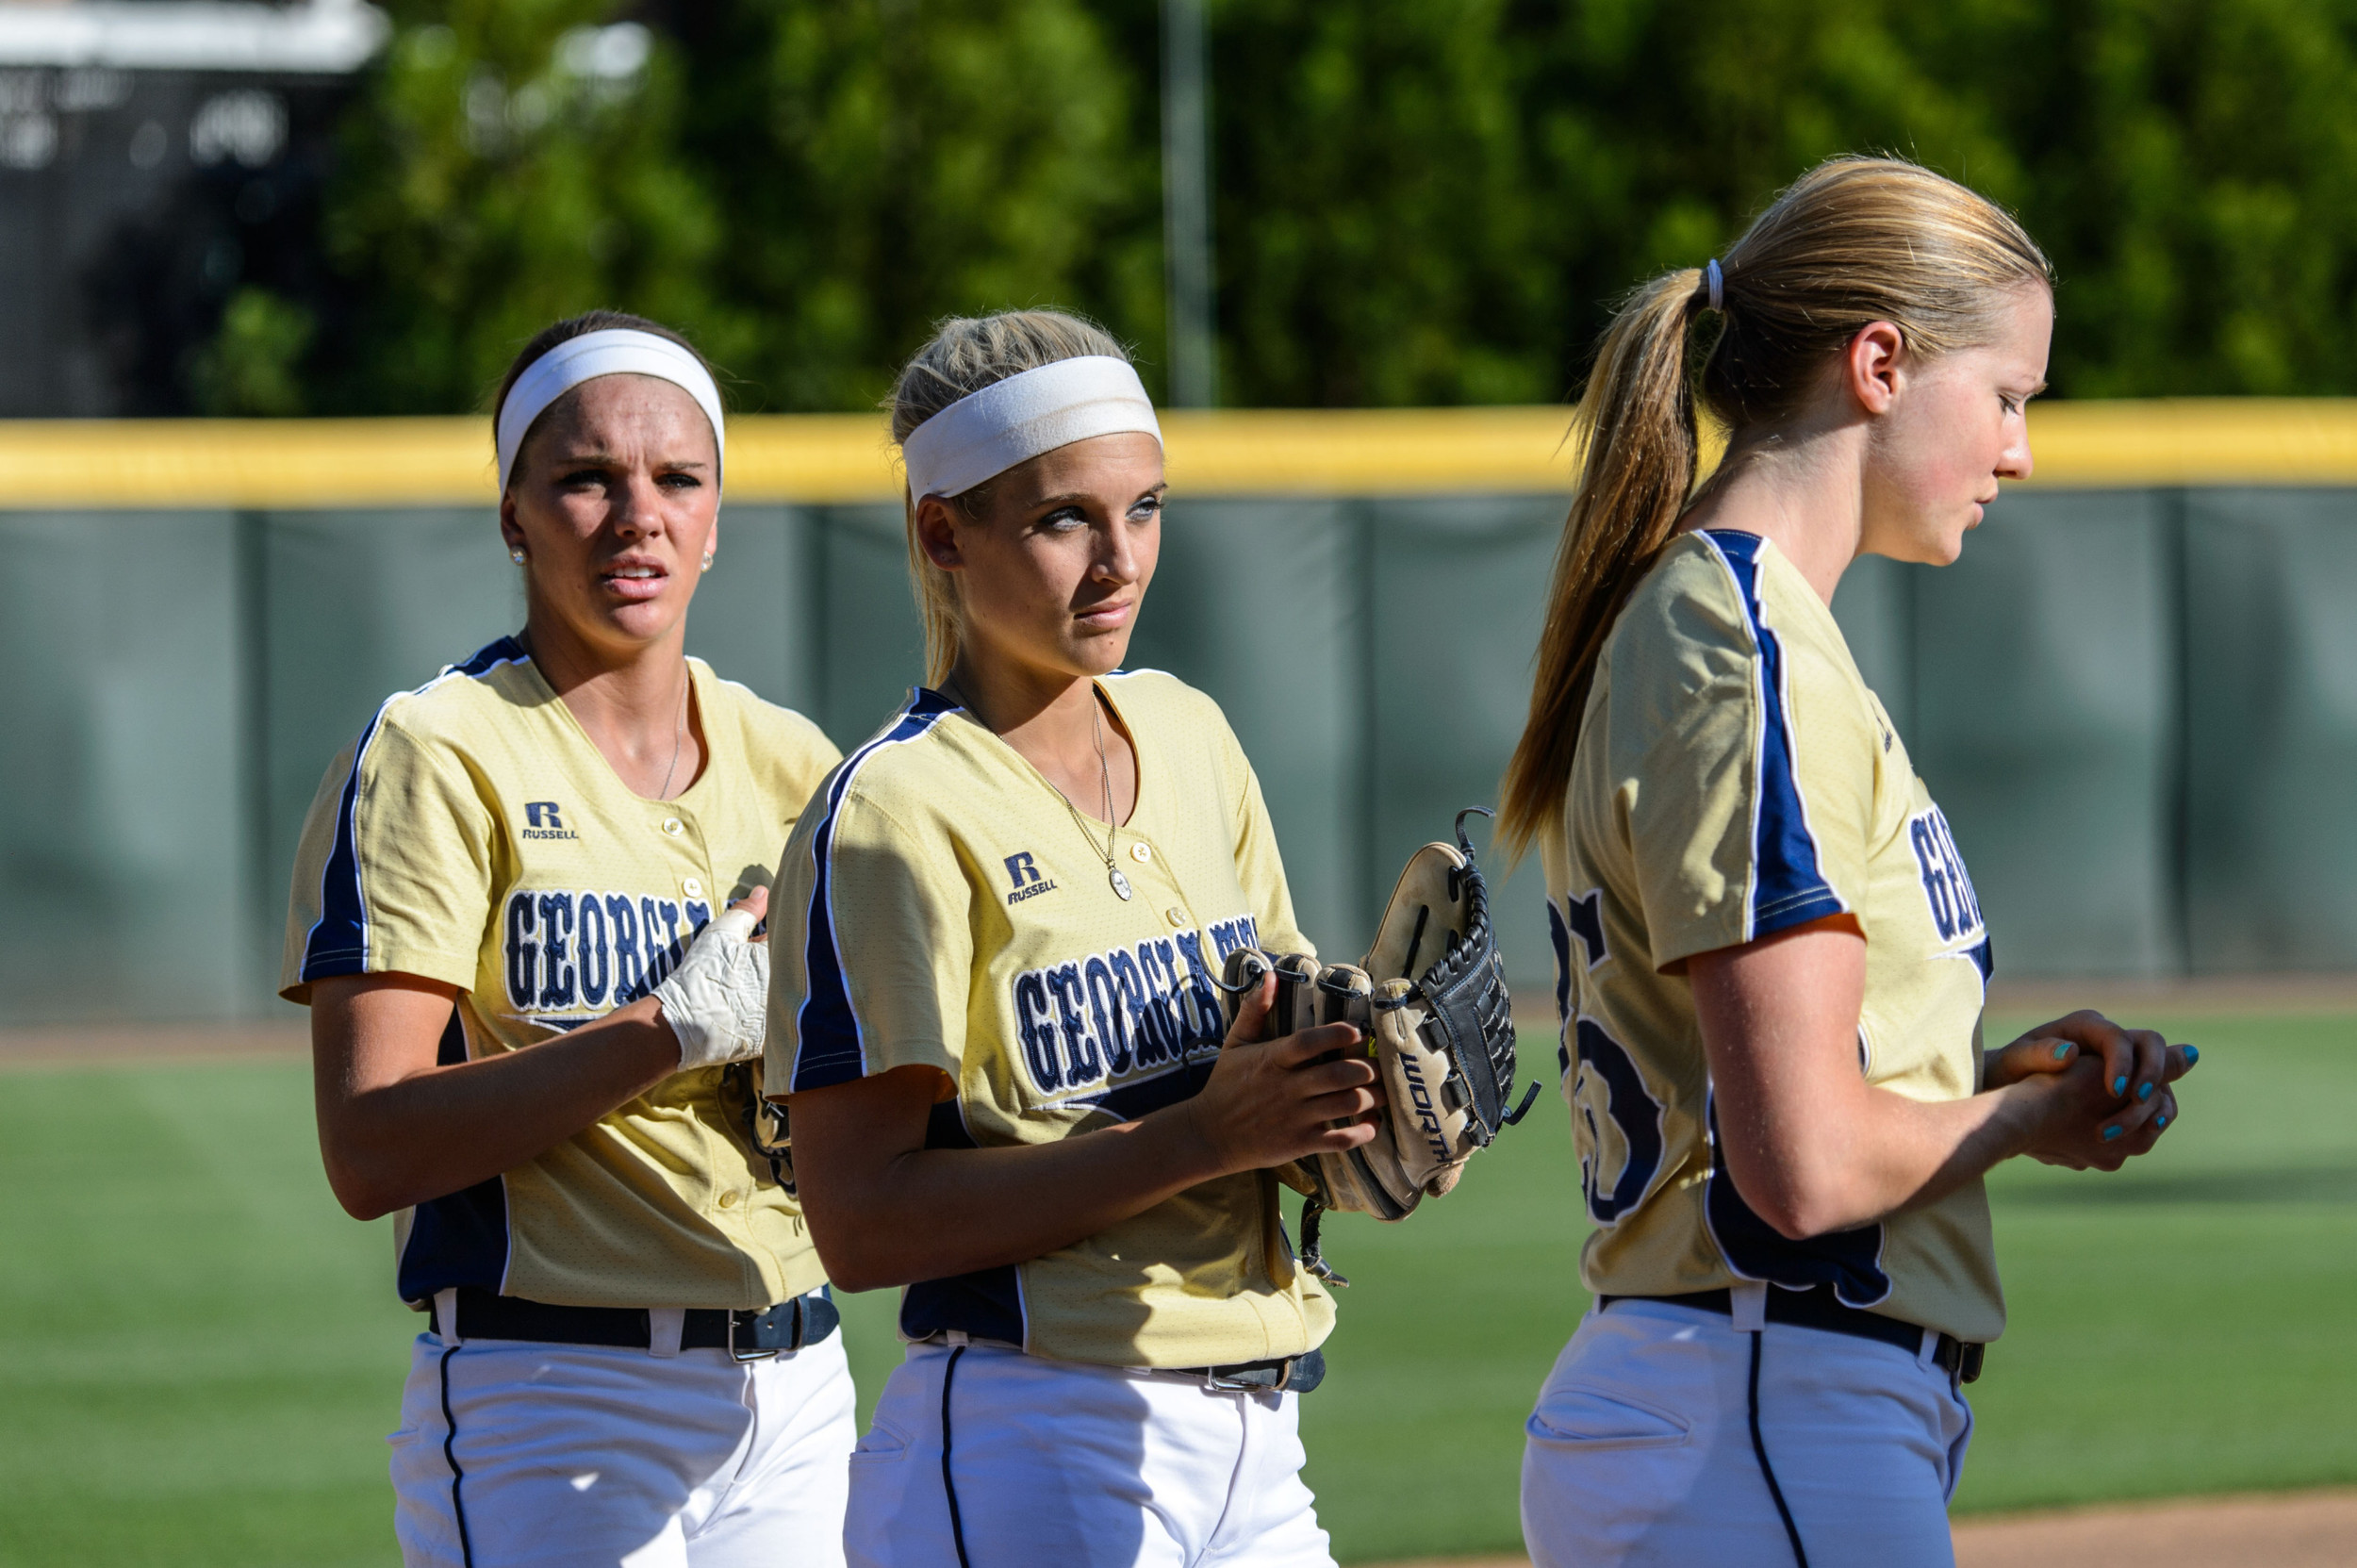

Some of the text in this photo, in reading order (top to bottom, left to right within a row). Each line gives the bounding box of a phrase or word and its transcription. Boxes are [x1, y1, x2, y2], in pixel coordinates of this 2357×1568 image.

[524, 801, 563, 829] R
[522, 829, 579, 839] RUSSELL
[1003, 850, 1042, 889] R
[1007, 878, 1058, 905] RUSSELL
[1012, 927, 1225, 1097] GEORGIA
[1399, 1052, 1453, 1164] WORTH
